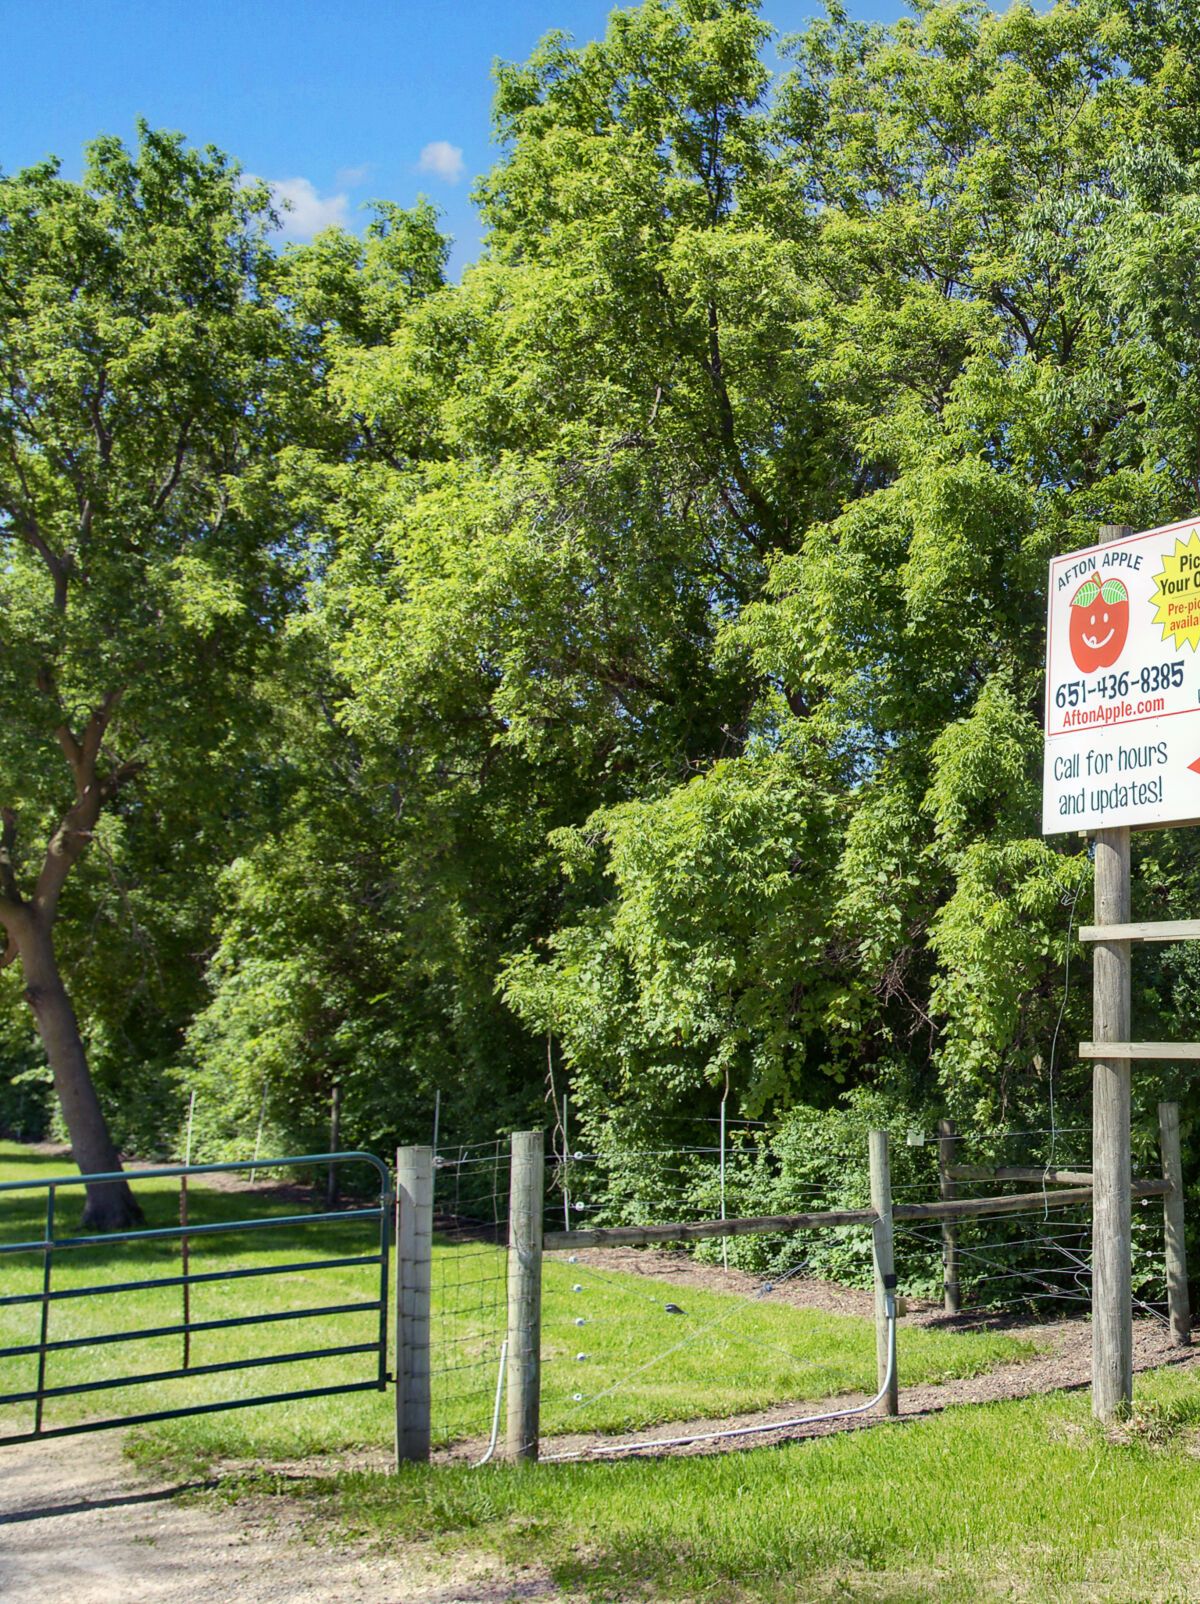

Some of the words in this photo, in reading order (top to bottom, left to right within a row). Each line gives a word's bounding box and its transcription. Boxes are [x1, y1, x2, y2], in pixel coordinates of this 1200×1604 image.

[1057, 555, 1098, 591] AFTON
[1102, 551, 1144, 571] APPLE
[1159, 572, 1190, 596] Your
[1055, 660, 1185, 709] 651-436-8385
[1063, 696, 1165, 728] AftonApple.com
[1054, 752, 1080, 782] Call
[1085, 750, 1113, 774] for
[1118, 741, 1168, 771] hours
[1058, 785, 1096, 816] and
[1100, 776, 1163, 813] updates!
